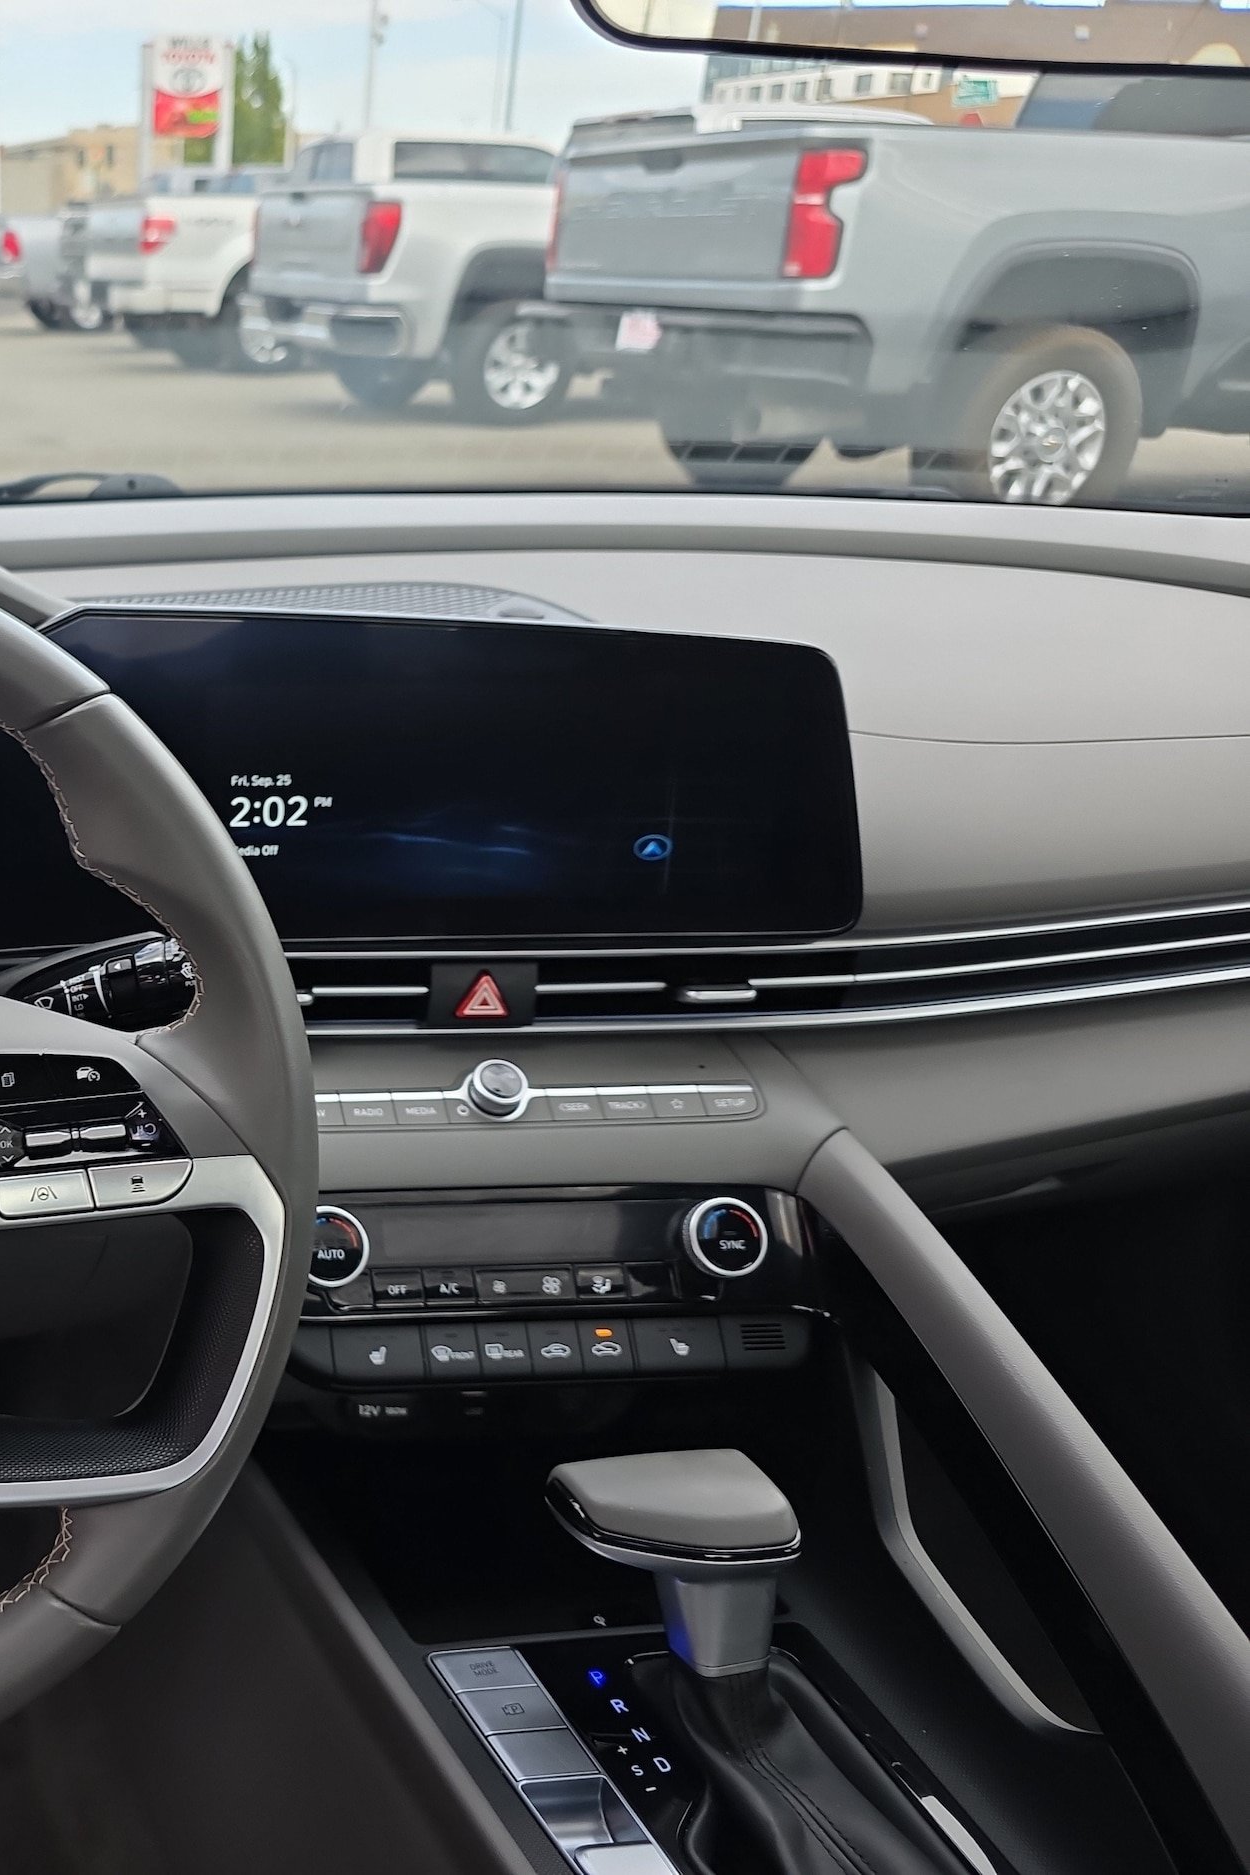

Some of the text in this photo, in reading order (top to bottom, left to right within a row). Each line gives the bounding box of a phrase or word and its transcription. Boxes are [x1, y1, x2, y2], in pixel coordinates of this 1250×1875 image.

[230, 773, 293, 788] Fri, Sep. 25
[228, 795, 333, 828] 2:02 PM
[237, 844, 280, 857] edia Off
[70, 984, 84, 993] OFF
[714, 1097, 746, 1107] SETUP
[353, 1108, 384, 1117] RADIO
[405, 1106, 437, 1115] MEDIA
[0, 1138, 14, 1150] OK
[718, 1239, 747, 1251] SYNC
[316, 1248, 346, 1260] AUTO
[387, 1284, 407, 1296] OFF
[438, 1282, 461, 1296] A/C
[503, 1348, 525, 1358] REAR
[357, 1403, 381, 1417] 12V
[469, 1659, 495, 1671] DRIVE
[473, 1666, 499, 1677] MODE
[588, 1670, 604, 1686] P
[609, 1698, 630, 1715] R
[630, 1726, 652, 1744] N
[630, 1764, 645, 1778] S
[652, 1756, 672, 1774] D
